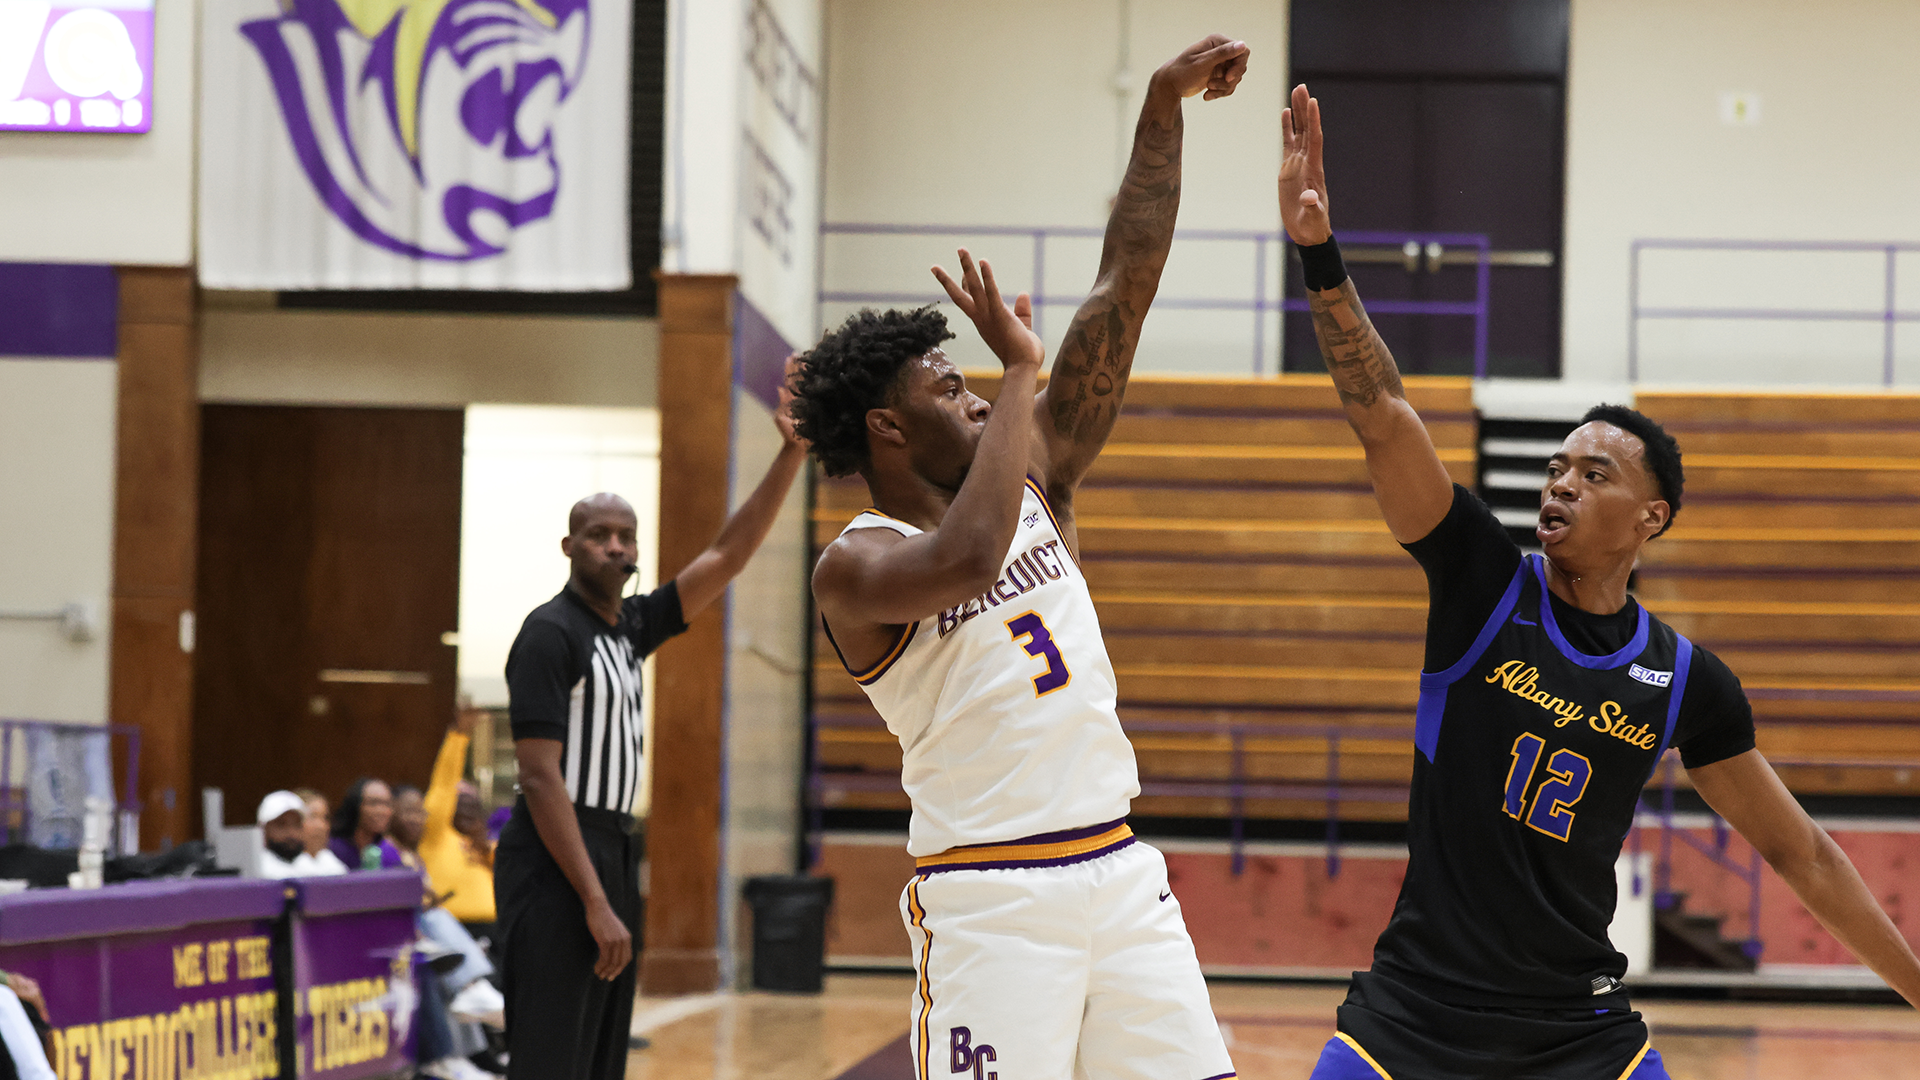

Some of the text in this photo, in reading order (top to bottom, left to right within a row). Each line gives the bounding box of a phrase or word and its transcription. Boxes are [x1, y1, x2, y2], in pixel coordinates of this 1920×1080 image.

[1003, 609, 1072, 699] 3
[1631, 664, 1670, 685] SIAC
[1485, 660, 1657, 750] Albany State
[1502, 731, 1593, 843] 12
[950, 1026, 998, 1080] BC
